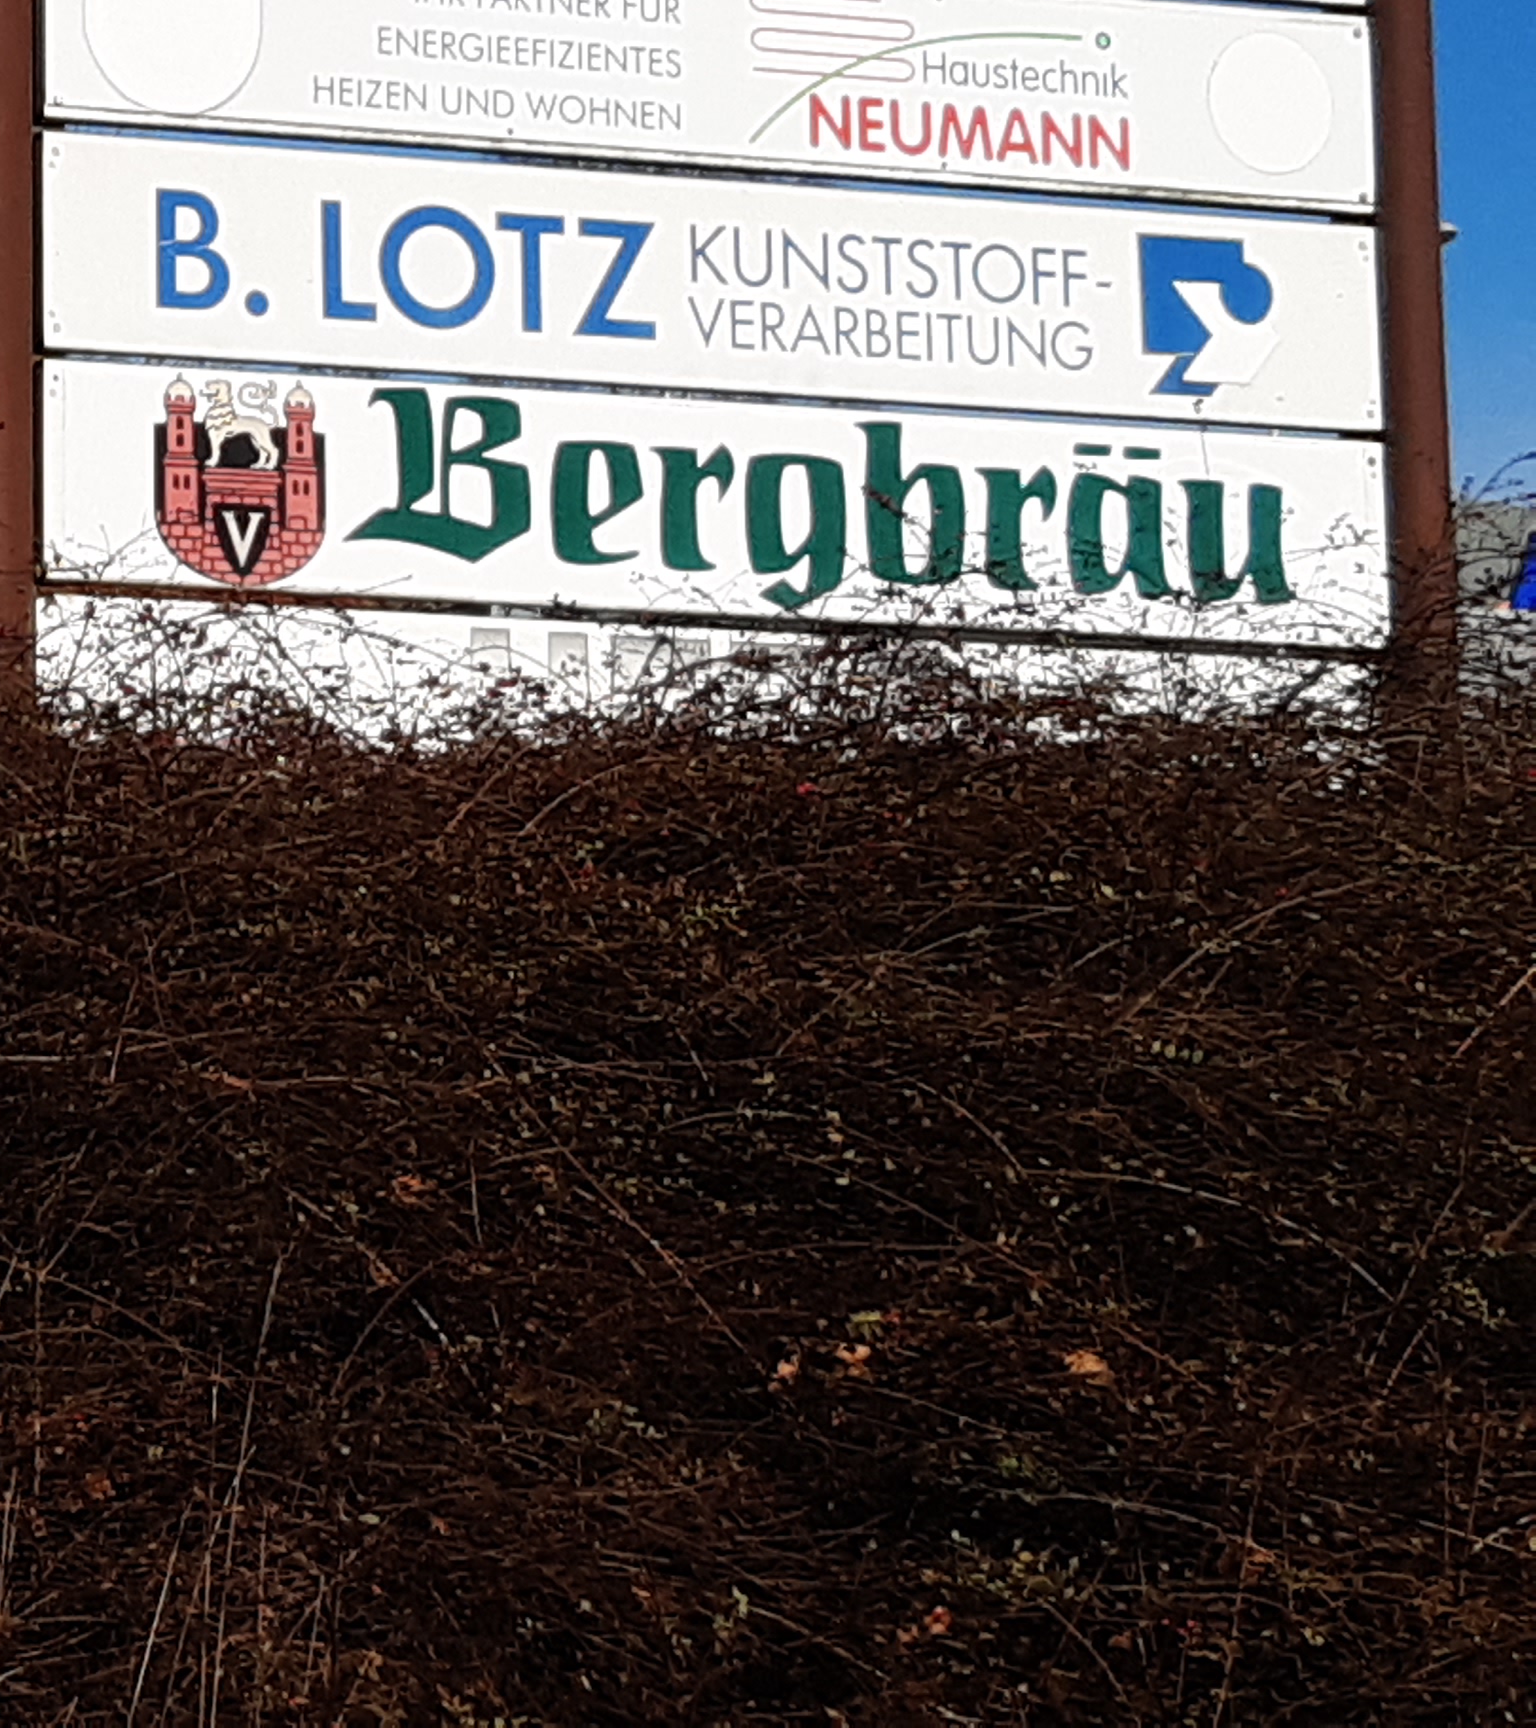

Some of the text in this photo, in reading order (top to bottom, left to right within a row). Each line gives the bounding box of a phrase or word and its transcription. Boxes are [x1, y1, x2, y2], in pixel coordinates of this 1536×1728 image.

[377, 25, 681, 79] ENERGIEEFIZIENTES
[922, 51, 1128, 98] Haustechnik
[313, 75, 681, 130] HEIZEN UND WOHNEN
[809, 93, 1129, 171] NEUMANN
[154, 187, 657, 340] B. LOTZ
[690, 224, 1112, 307] KUNSTSTOFF-
[688, 296, 1093, 370] VERARBEITUNG
[344, 387, 1291, 610] Bergbräu
